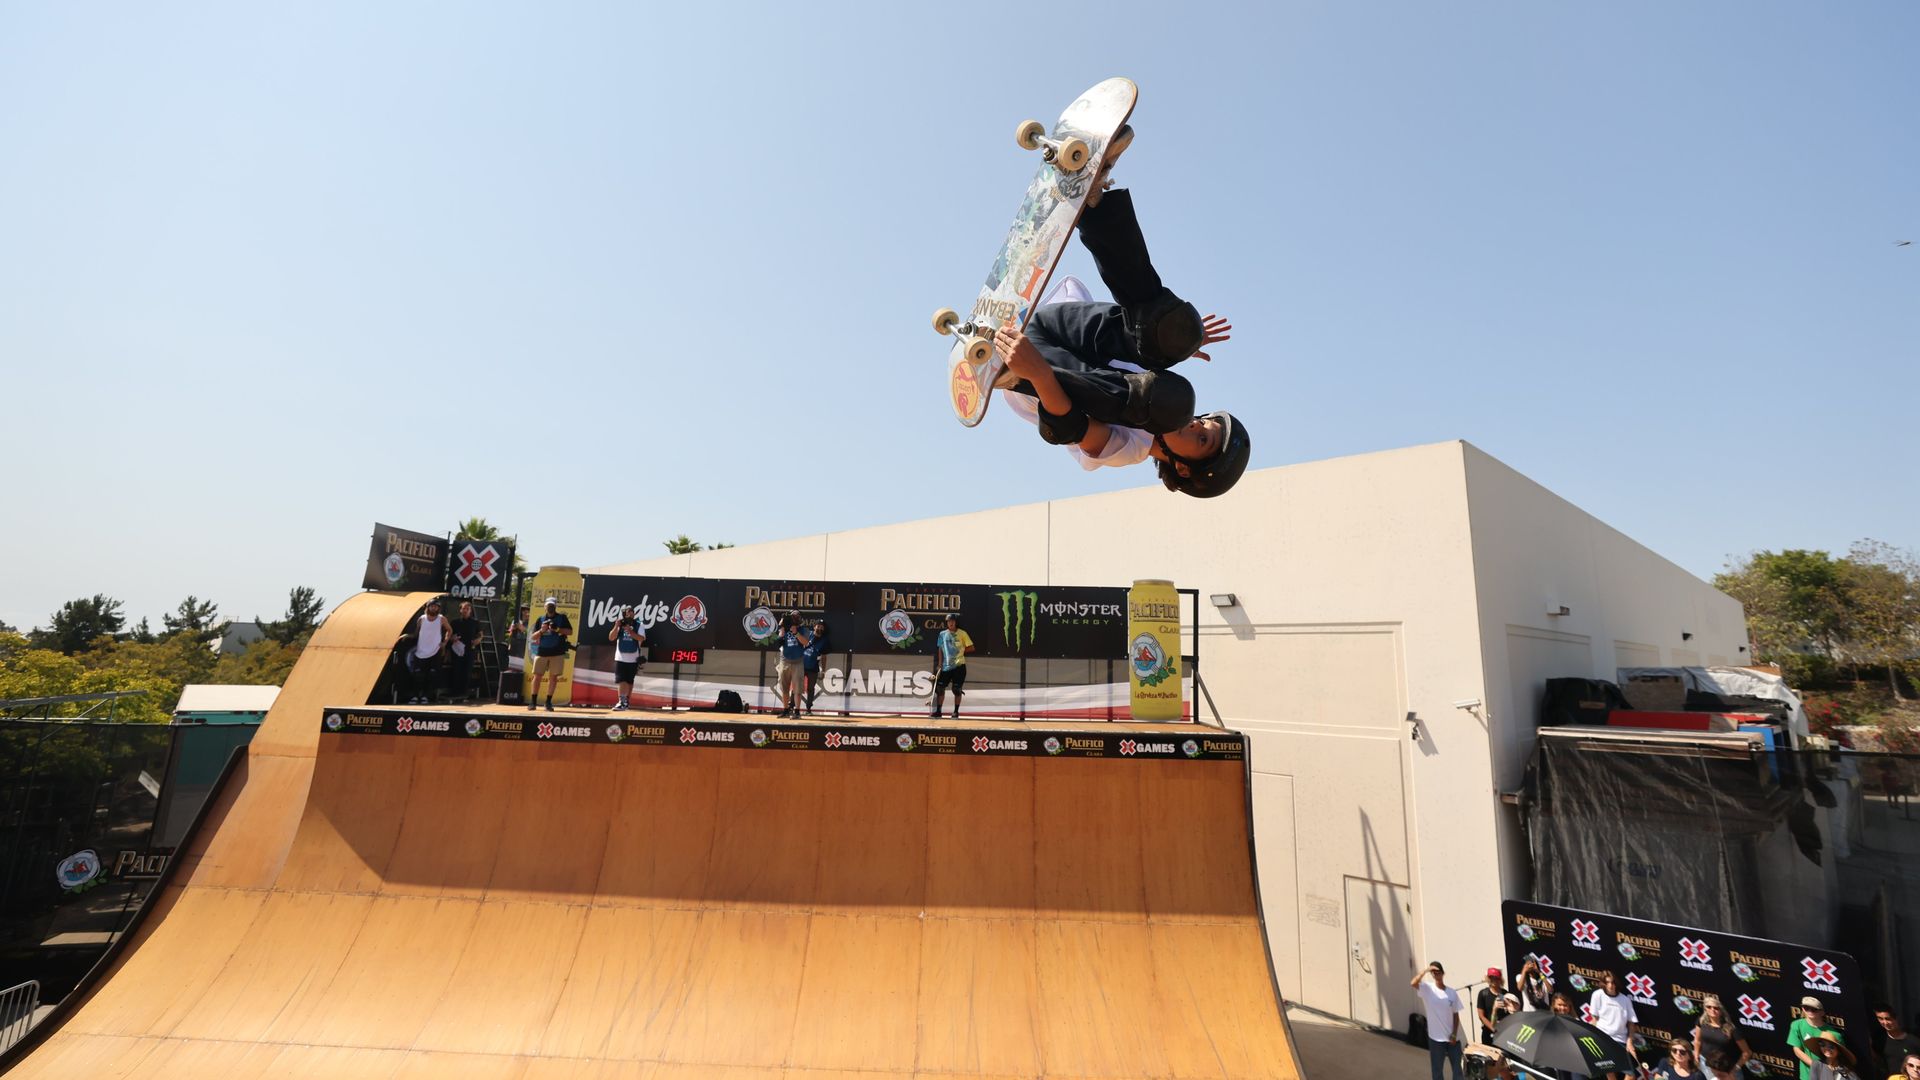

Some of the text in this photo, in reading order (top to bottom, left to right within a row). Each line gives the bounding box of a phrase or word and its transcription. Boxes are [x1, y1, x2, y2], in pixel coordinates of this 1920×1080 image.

[386, 532, 437, 559] PACIFICO
[451, 585, 496, 598] GAMES
[745, 586, 826, 609] PACIFICO
[880, 588, 961, 611] PACIFICO
[1040, 601, 1122, 617] MONSTER
[924, 619, 944, 630] CLA
[672, 651, 698, 662] 13:46
[823, 668, 933, 697] GAMES
[347, 714, 383, 725] PACIFICO
[486, 719, 523, 731] PACIFICO
[413, 721, 449, 731] GAMES
[554, 726, 591, 737] GAMES
[627, 725, 665, 736] PACIFICO
[696, 731, 734, 742] GAMES
[771, 730, 810, 740] PACIFICO
[841, 735, 880, 746] GAMES
[918, 734, 957, 745] PACIFICO
[989, 740, 1027, 750] GAMES
[1065, 737, 1104, 748] PACIFICO
[1136, 743, 1175, 753] GAMES
[1203, 740, 1242, 751] PACIFICO
[1516, 913, 1555, 929] PACIFICO
[1616, 931, 1661, 948] PACIFICO
[1572, 940, 1601, 951] GAMES
[1729, 950, 1780, 969] PACIFICO
[1680, 960, 1713, 972] GAMES
[1803, 981, 1841, 994] GAMES
[1740, 1018, 1775, 1031] GAMES
[1636, 1026, 1672, 1040] ACIFICO
[1752, 1053, 1794, 1068] ACIFICO
